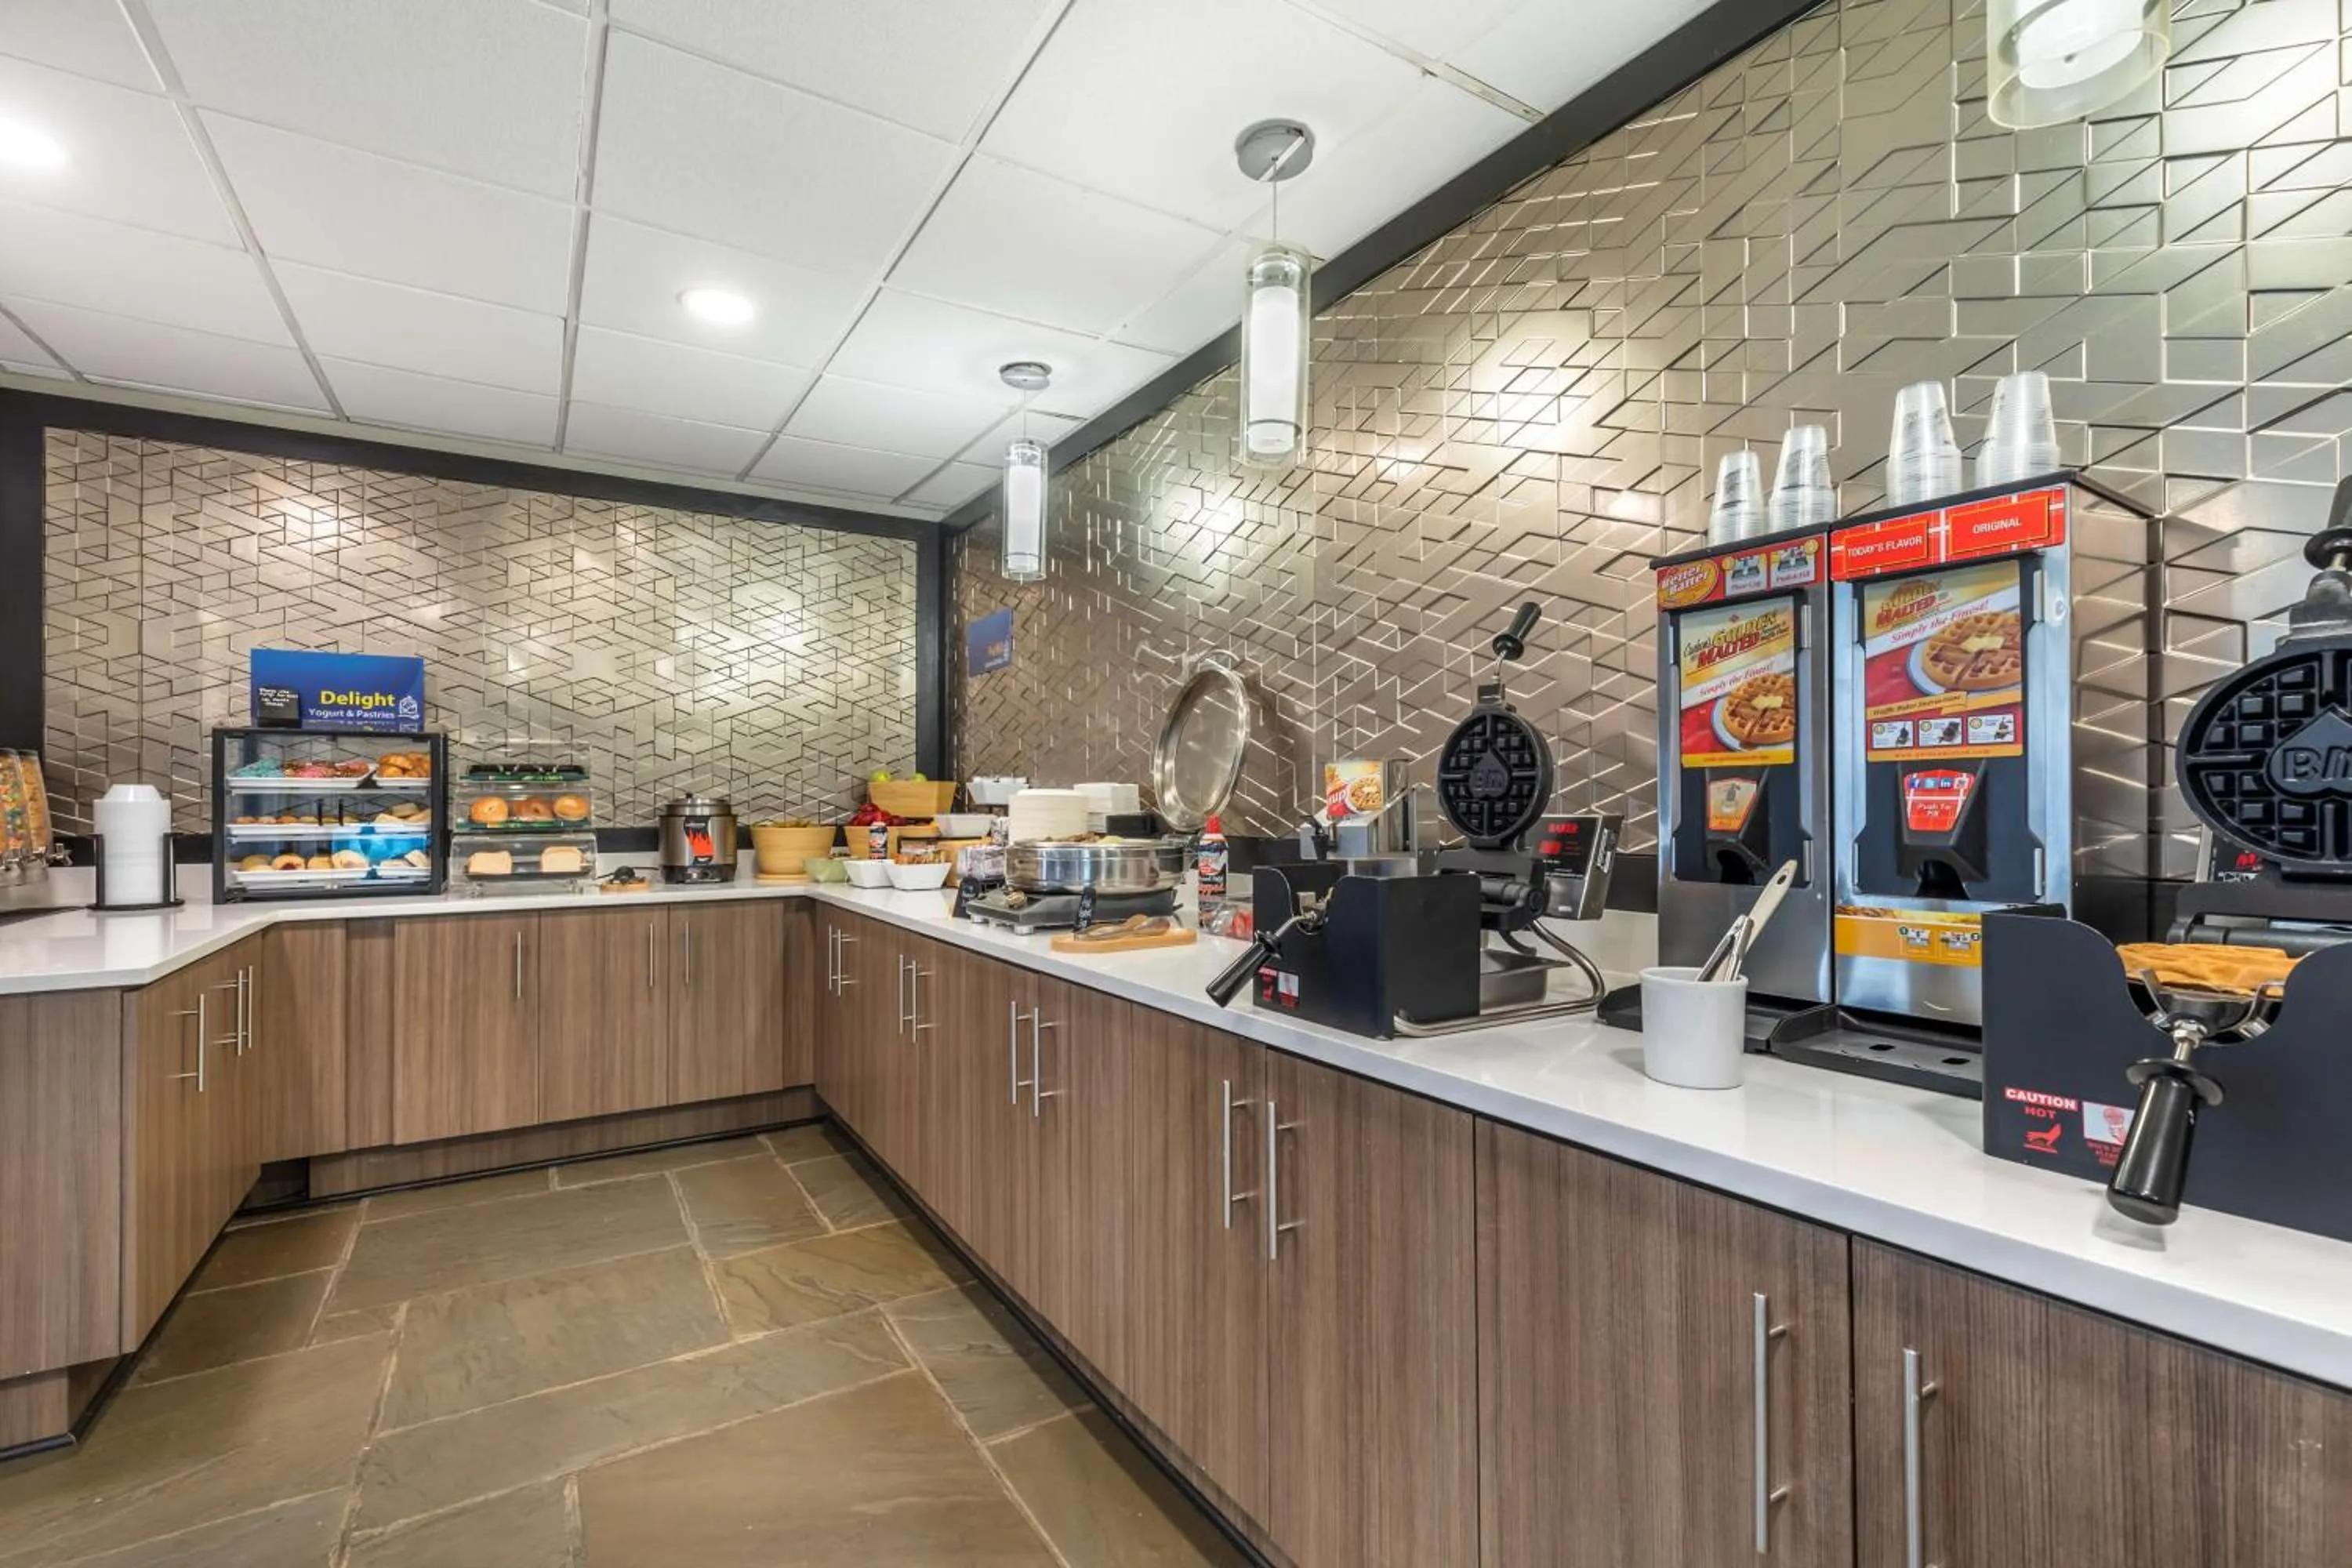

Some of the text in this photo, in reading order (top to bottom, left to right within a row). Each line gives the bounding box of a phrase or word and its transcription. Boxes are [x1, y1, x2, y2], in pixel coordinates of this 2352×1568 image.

[1973, 518, 2022, 534] ORIGINAL
[1847, 535, 1922, 557] TODAY'S FLAVOR
[1876, 594, 1937, 627] MALTED
[1891, 622, 1928, 643] Simply
[1697, 630, 1761, 668] MALTED
[320, 690, 395, 710] Delight
[308, 708, 395, 719] Yogurt & Pastries
[2005, 1087, 2077, 1110] CAUTION
[2024, 1106, 2056, 1119] HOT
